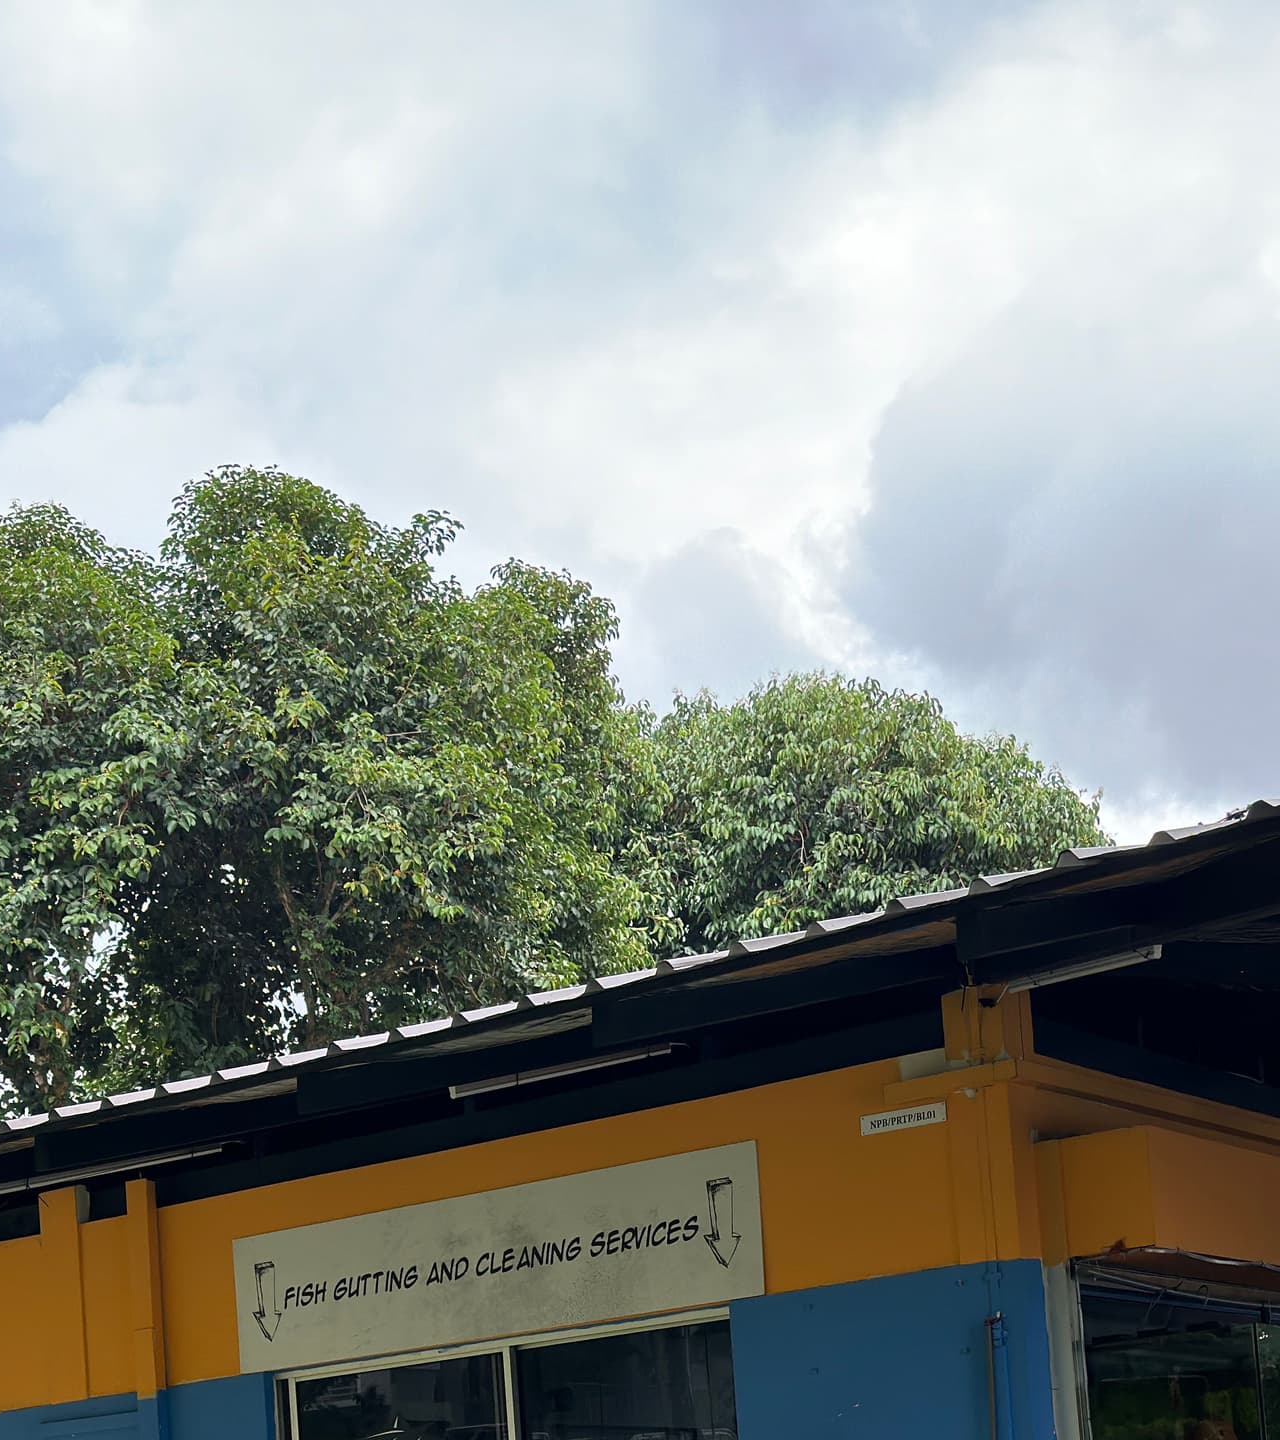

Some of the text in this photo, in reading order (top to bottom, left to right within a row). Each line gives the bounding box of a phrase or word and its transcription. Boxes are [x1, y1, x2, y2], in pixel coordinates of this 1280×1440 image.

[870, 1110, 937, 1130] NPB/PRTP/BL01
[283, 1214, 700, 1310] FISH GUTTING AND CLEANING SERVICES
